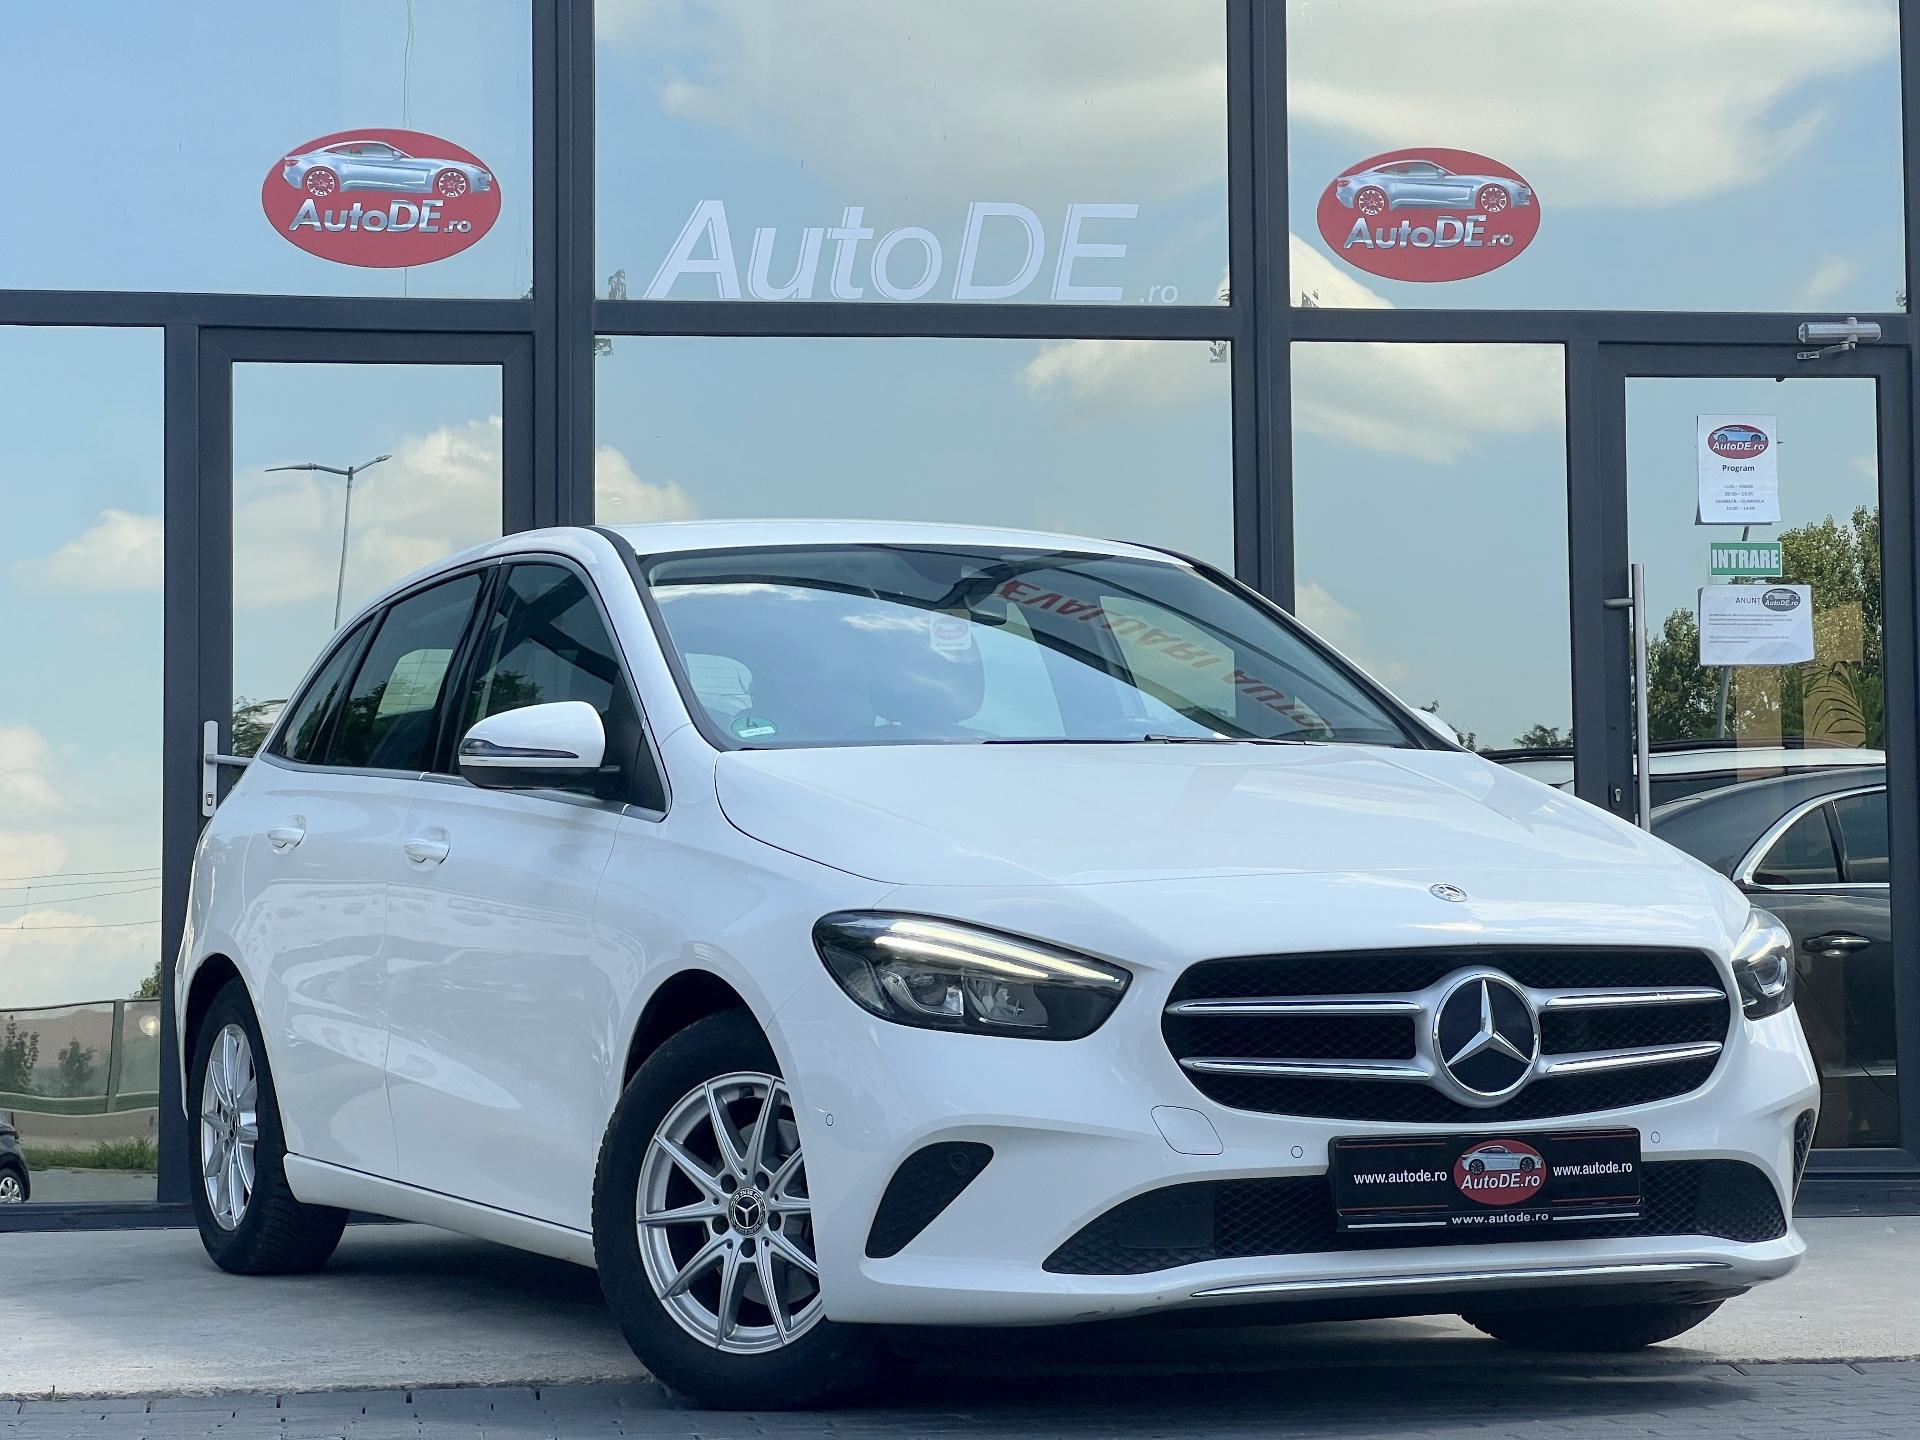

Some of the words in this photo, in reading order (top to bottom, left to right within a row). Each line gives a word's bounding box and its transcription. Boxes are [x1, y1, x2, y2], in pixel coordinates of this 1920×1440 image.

[288, 198, 472, 233] AutoDE.ro
[1343, 214, 1514, 250] AutoDE.ro
[1712, 441, 1765, 451] AutoDE.ro
[1722, 464, 1755, 473] Program
[1711, 549, 1780, 570] INTRARE
[1353, 1169, 1448, 1186] www.autode.ro
[1552, 1161, 1633, 1178] www.autode.ro
[1460, 1172, 1541, 1191] AutoDE.ro
[1451, 1211, 1550, 1225] www.autode.ro
